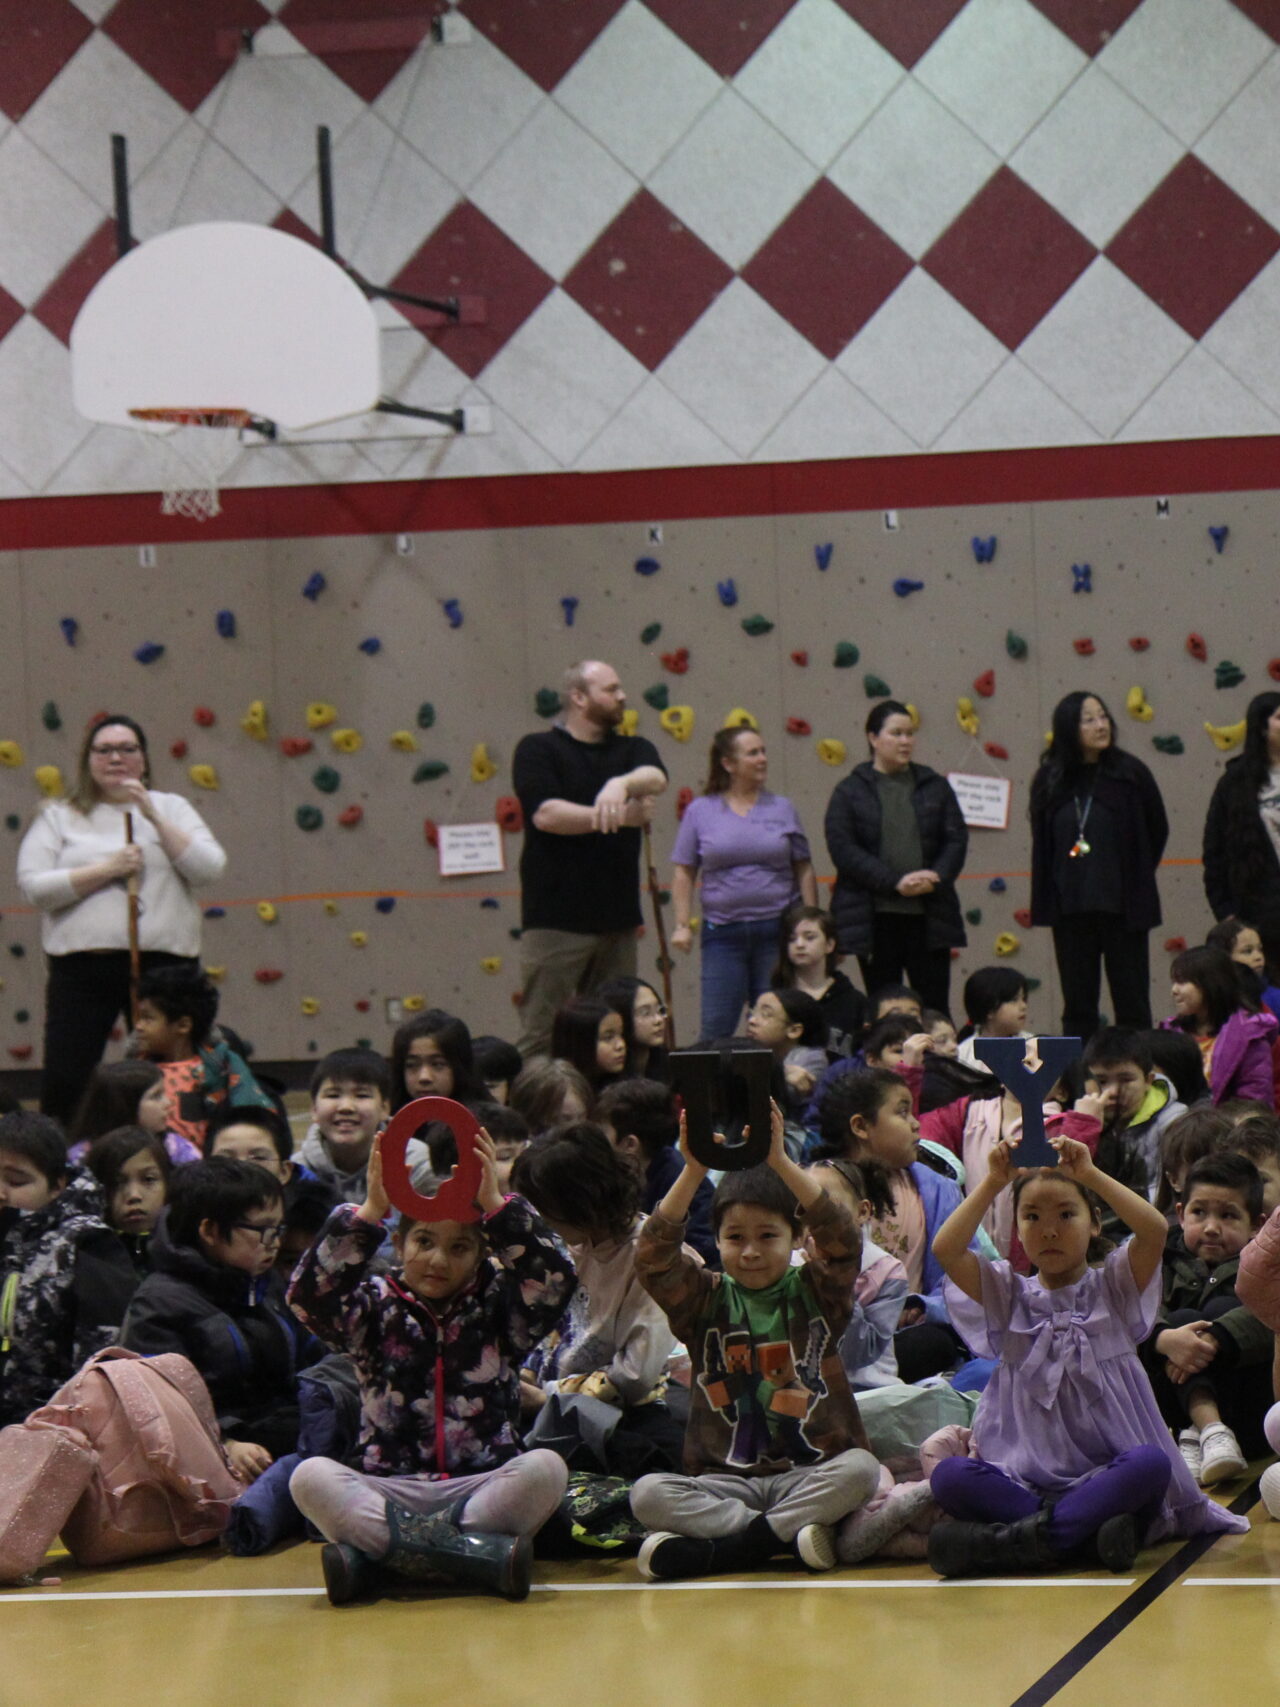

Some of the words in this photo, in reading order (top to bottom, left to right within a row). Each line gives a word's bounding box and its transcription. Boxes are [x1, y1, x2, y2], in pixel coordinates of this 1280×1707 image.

[650, 527, 660, 542] K
[885, 512, 896, 529] L
[1157, 499, 1169, 515] M
[669, 1049, 773, 1171] U
[974, 1037, 1081, 1167] Y
[380, 1096, 485, 1222] Q
